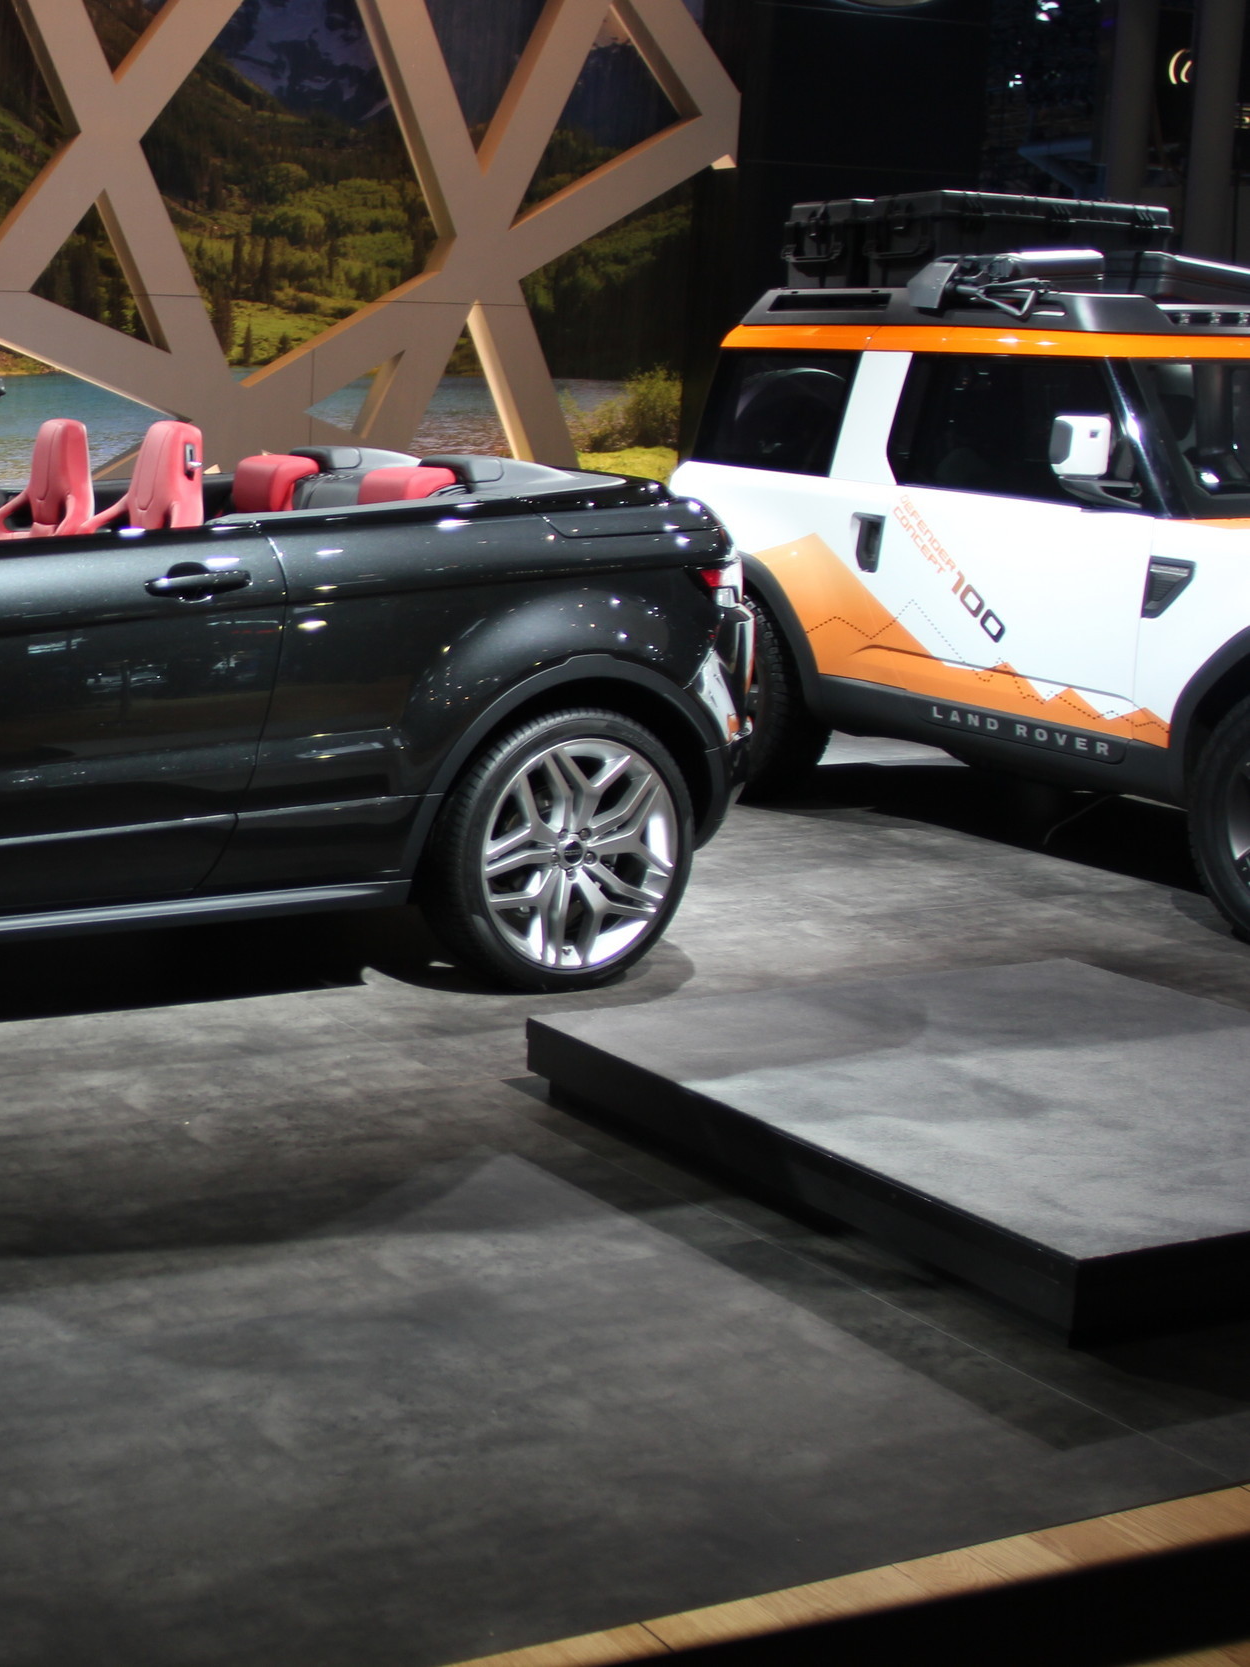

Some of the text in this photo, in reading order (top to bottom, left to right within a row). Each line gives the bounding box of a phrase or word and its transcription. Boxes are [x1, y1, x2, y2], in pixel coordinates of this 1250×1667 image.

[893, 506, 946, 574] CONCEPT
[900, 494, 956, 572] DEFENDER
[951, 570, 1006, 643] 100
[932, 705, 1109, 756] LAND ROVER
